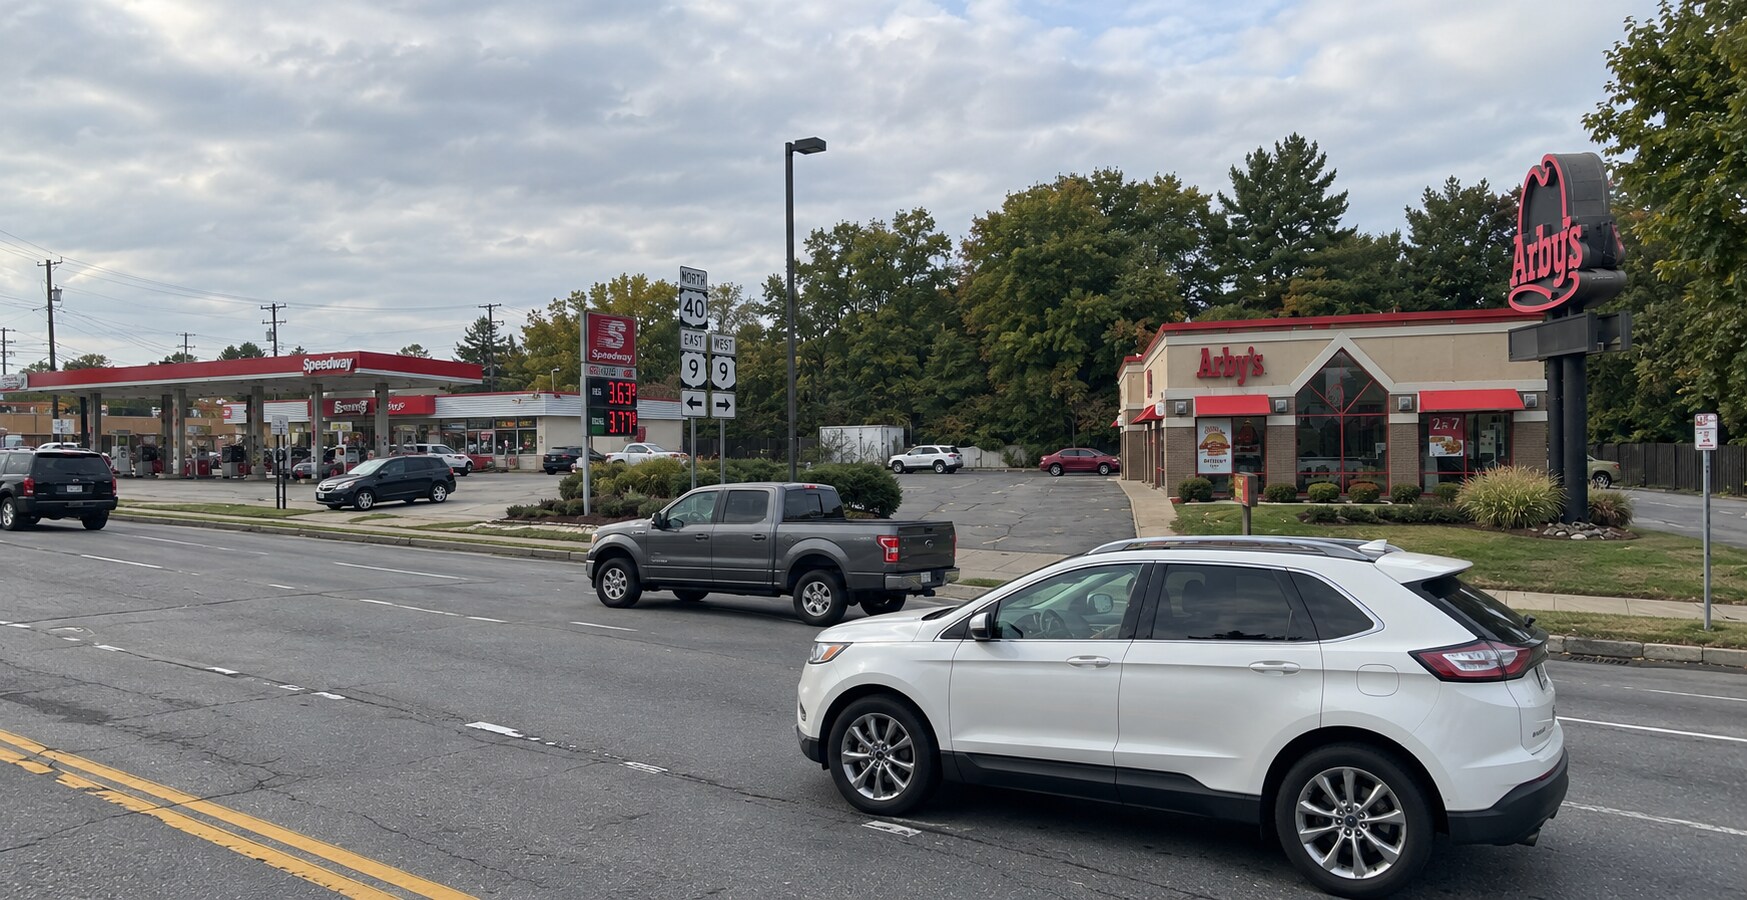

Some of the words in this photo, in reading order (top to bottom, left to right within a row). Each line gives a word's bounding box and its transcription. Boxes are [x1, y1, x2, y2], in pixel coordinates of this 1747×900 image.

[1510, 216, 1582, 288] Arby's
[682, 271, 705, 286] NORTH
[684, 298, 704, 318] 40
[685, 333, 703, 347] EAST
[714, 336, 732, 351] WEST
[303, 357, 353, 374] Speedway
[592, 349, 633, 365] Speedway
[1197, 346, 1264, 385] Arby's
[689, 359, 698, 378] 9
[719, 362, 728, 381] 9
[1433, 417, 1440, 430] 2
[1452, 417, 1460, 430] 7
